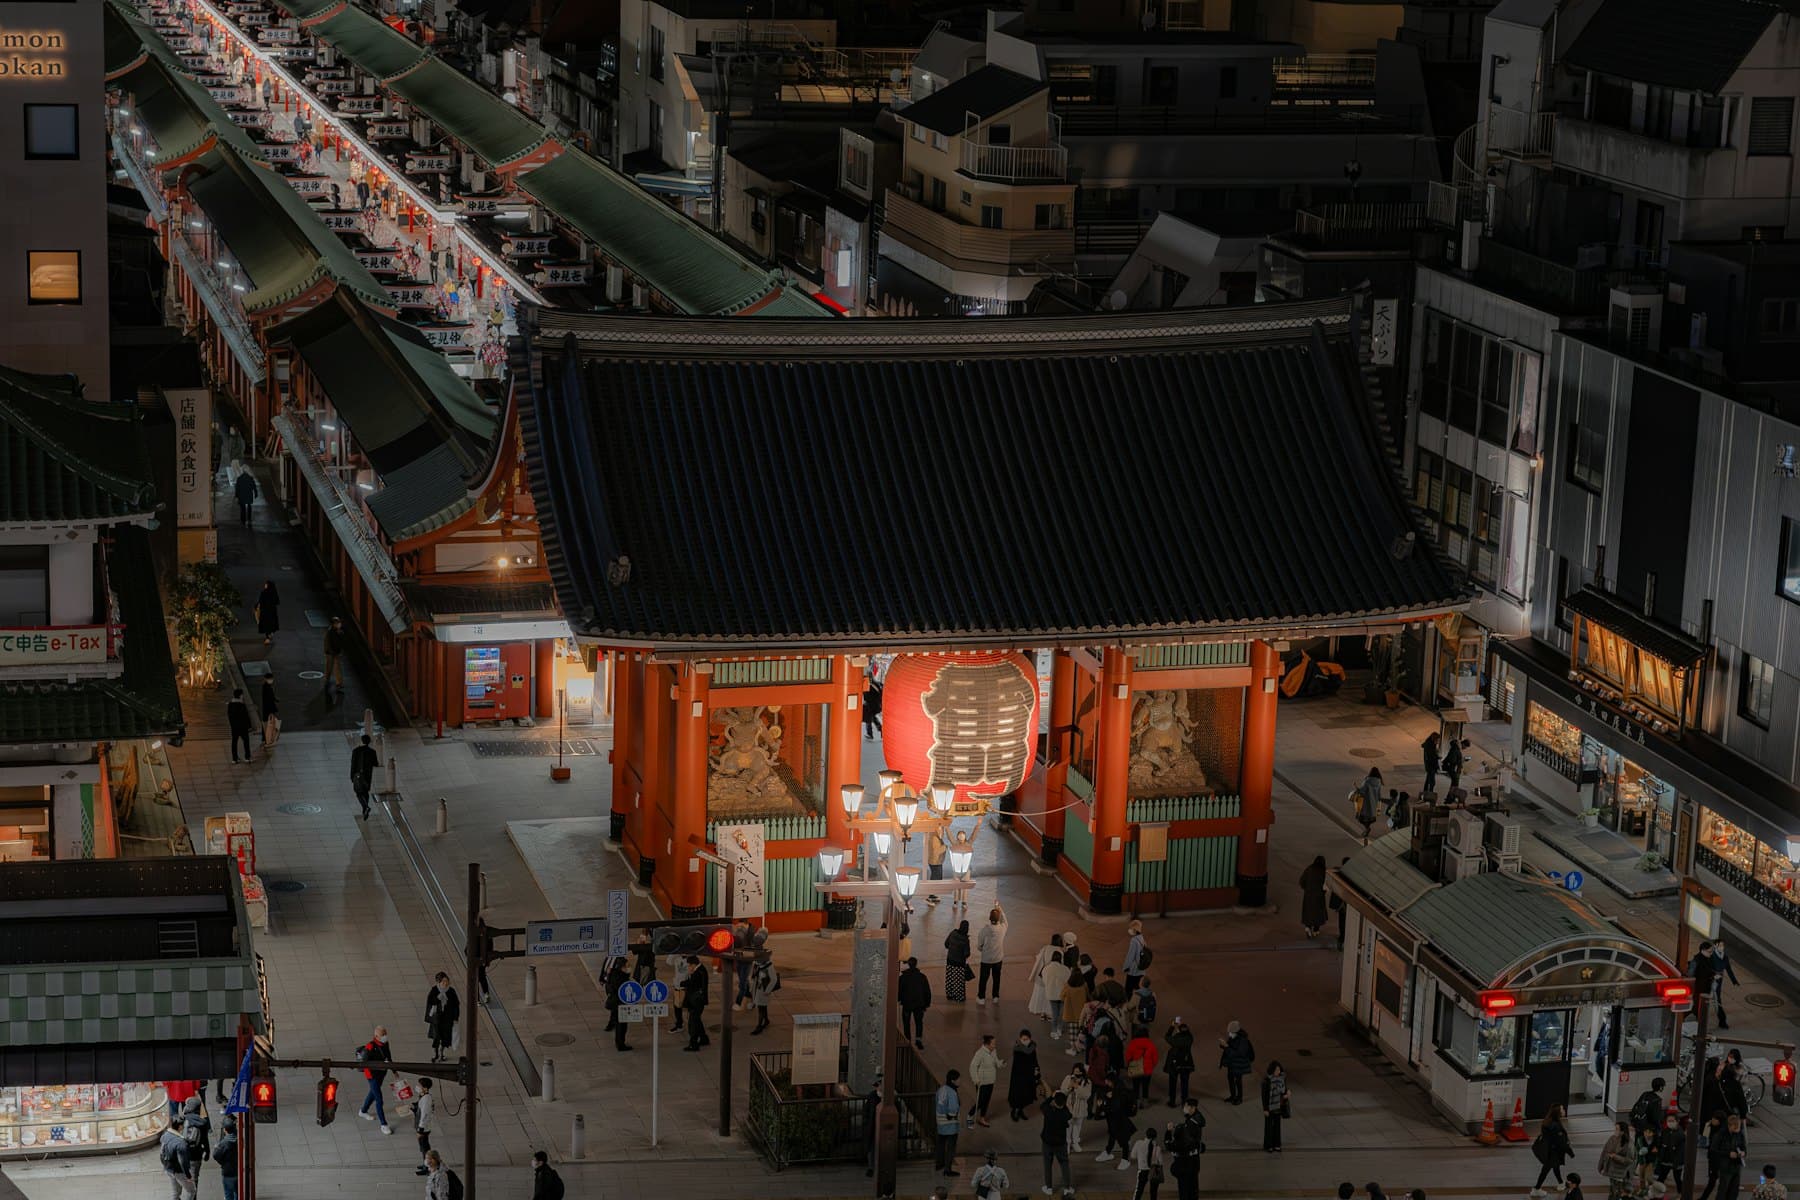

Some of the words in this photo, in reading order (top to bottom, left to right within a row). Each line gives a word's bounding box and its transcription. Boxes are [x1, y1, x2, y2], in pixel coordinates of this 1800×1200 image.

[3, 34, 62, 48] mon
[550, 269, 582, 282] 仲見世
[1376, 305, 1393, 359] 天ぷら
[532, 943, 580, 953] Kaminarimon
[582, 942, 600, 950] Gate
